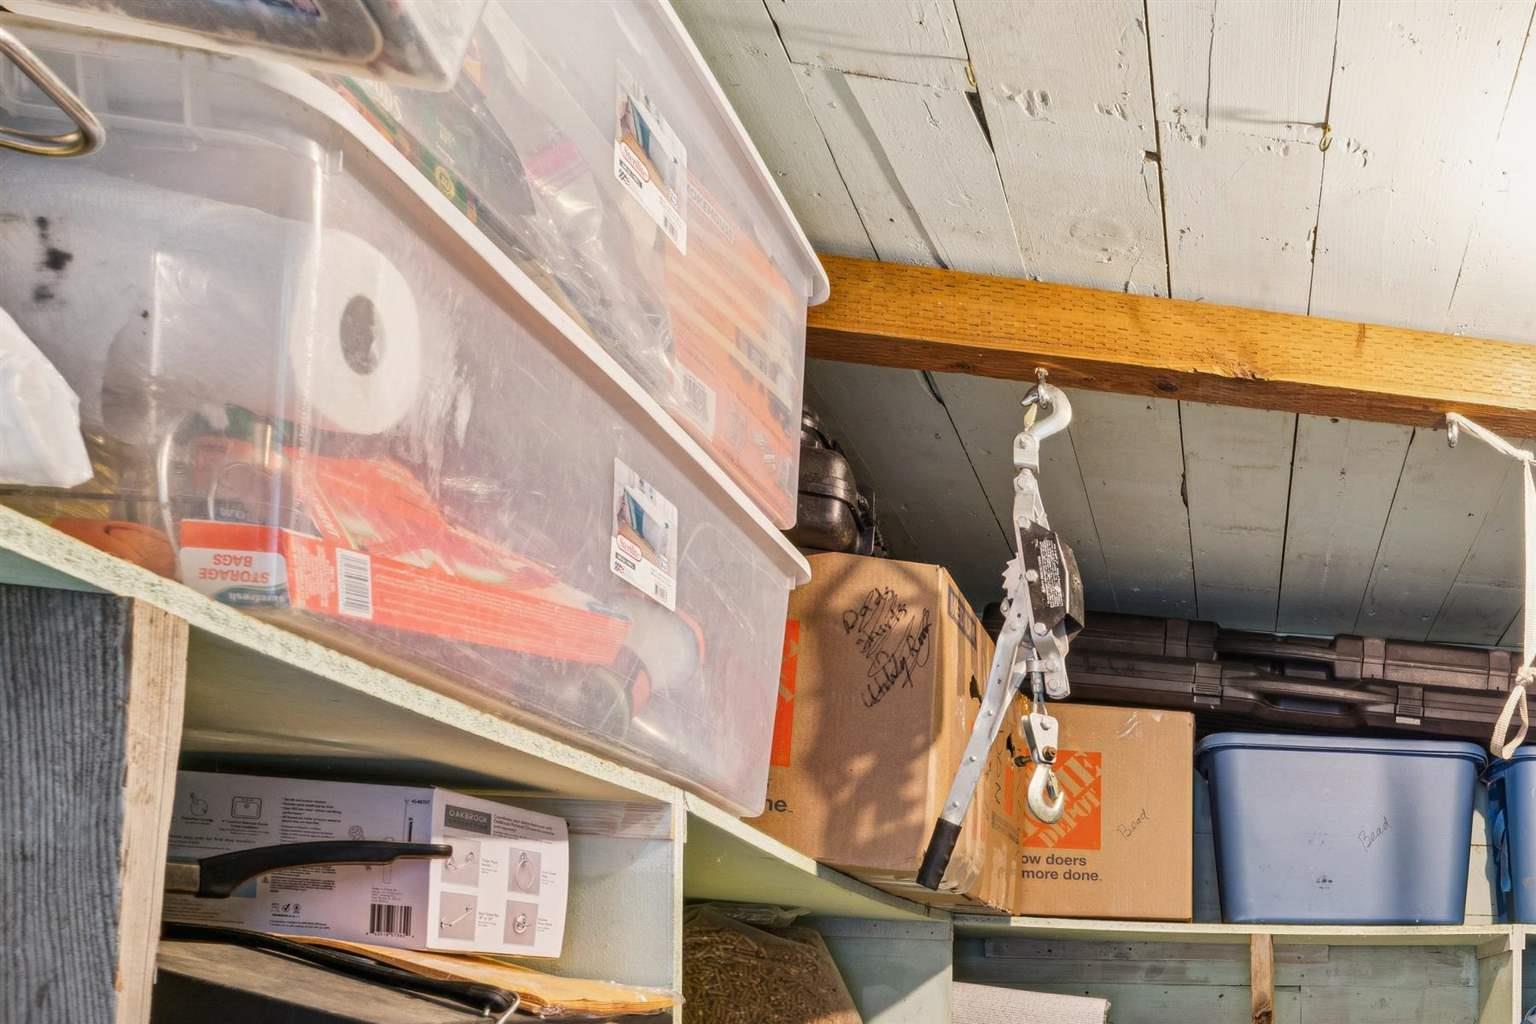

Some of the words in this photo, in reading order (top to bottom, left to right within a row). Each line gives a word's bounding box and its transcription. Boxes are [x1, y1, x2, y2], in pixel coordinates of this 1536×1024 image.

[212, 553, 254, 568] BAGS
[199, 567, 270, 584] STORAGE
[449, 809, 488, 823] OAKBROOK
[1021, 855, 1041, 866] ow
[1046, 851, 1088, 867] doers
[1021, 867, 1059, 881] more
